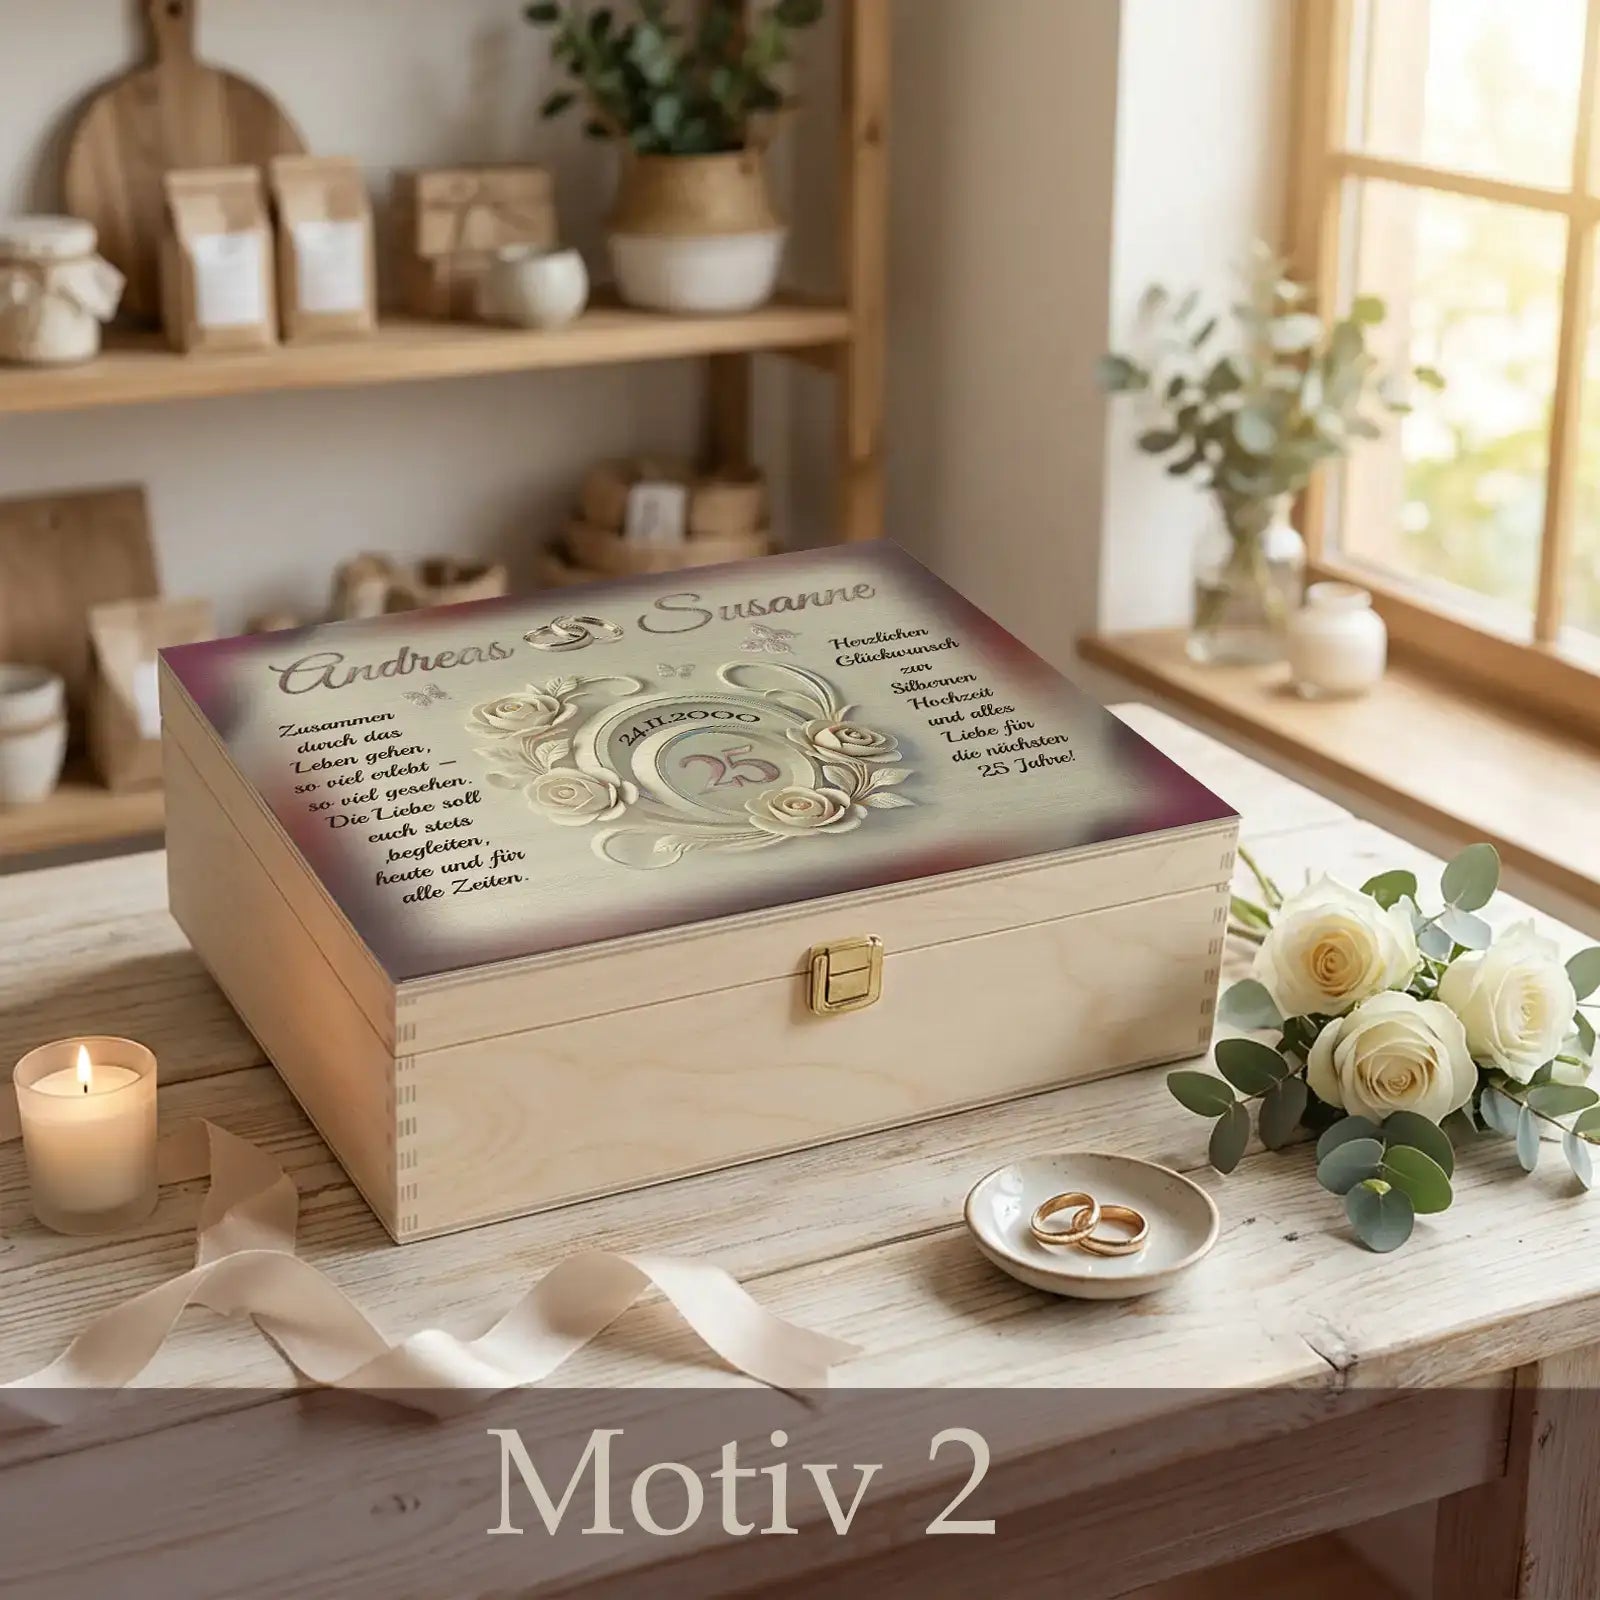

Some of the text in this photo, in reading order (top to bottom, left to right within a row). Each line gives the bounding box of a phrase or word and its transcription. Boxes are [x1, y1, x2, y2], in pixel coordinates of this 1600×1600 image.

[269, 581, 876, 695] Andreas Susanne
[828, 628, 929, 649] Herzlichen
[836, 637, 960, 667] Glückwunsch
[900, 663, 933, 674] zur
[891, 672, 976, 694] Silbernen
[907, 688, 994, 710] Hochzeit
[279, 712, 395, 738] Zusammen
[928, 703, 1015, 726] und alles
[297, 730, 402, 754] durch das
[941, 719, 1035, 743] Liebe für
[290, 745, 431, 773] Leben gehen,
[952, 734, 1069, 762] die nächsten
[679, 744, 780, 795] 25
[978, 750, 1076, 777] 25 Jahre!
[294, 783, 320, 794] so
[327, 770, 364, 788] viel
[371, 762, 429, 780] erlebt
[309, 775, 472, 811] so viel gesehen.
[325, 790, 482, 829] Die Liebe soll
[368, 817, 473, 843] euch stets
[376, 849, 526, 886] heute und für
[403, 874, 529, 904] alle Zeiten.
